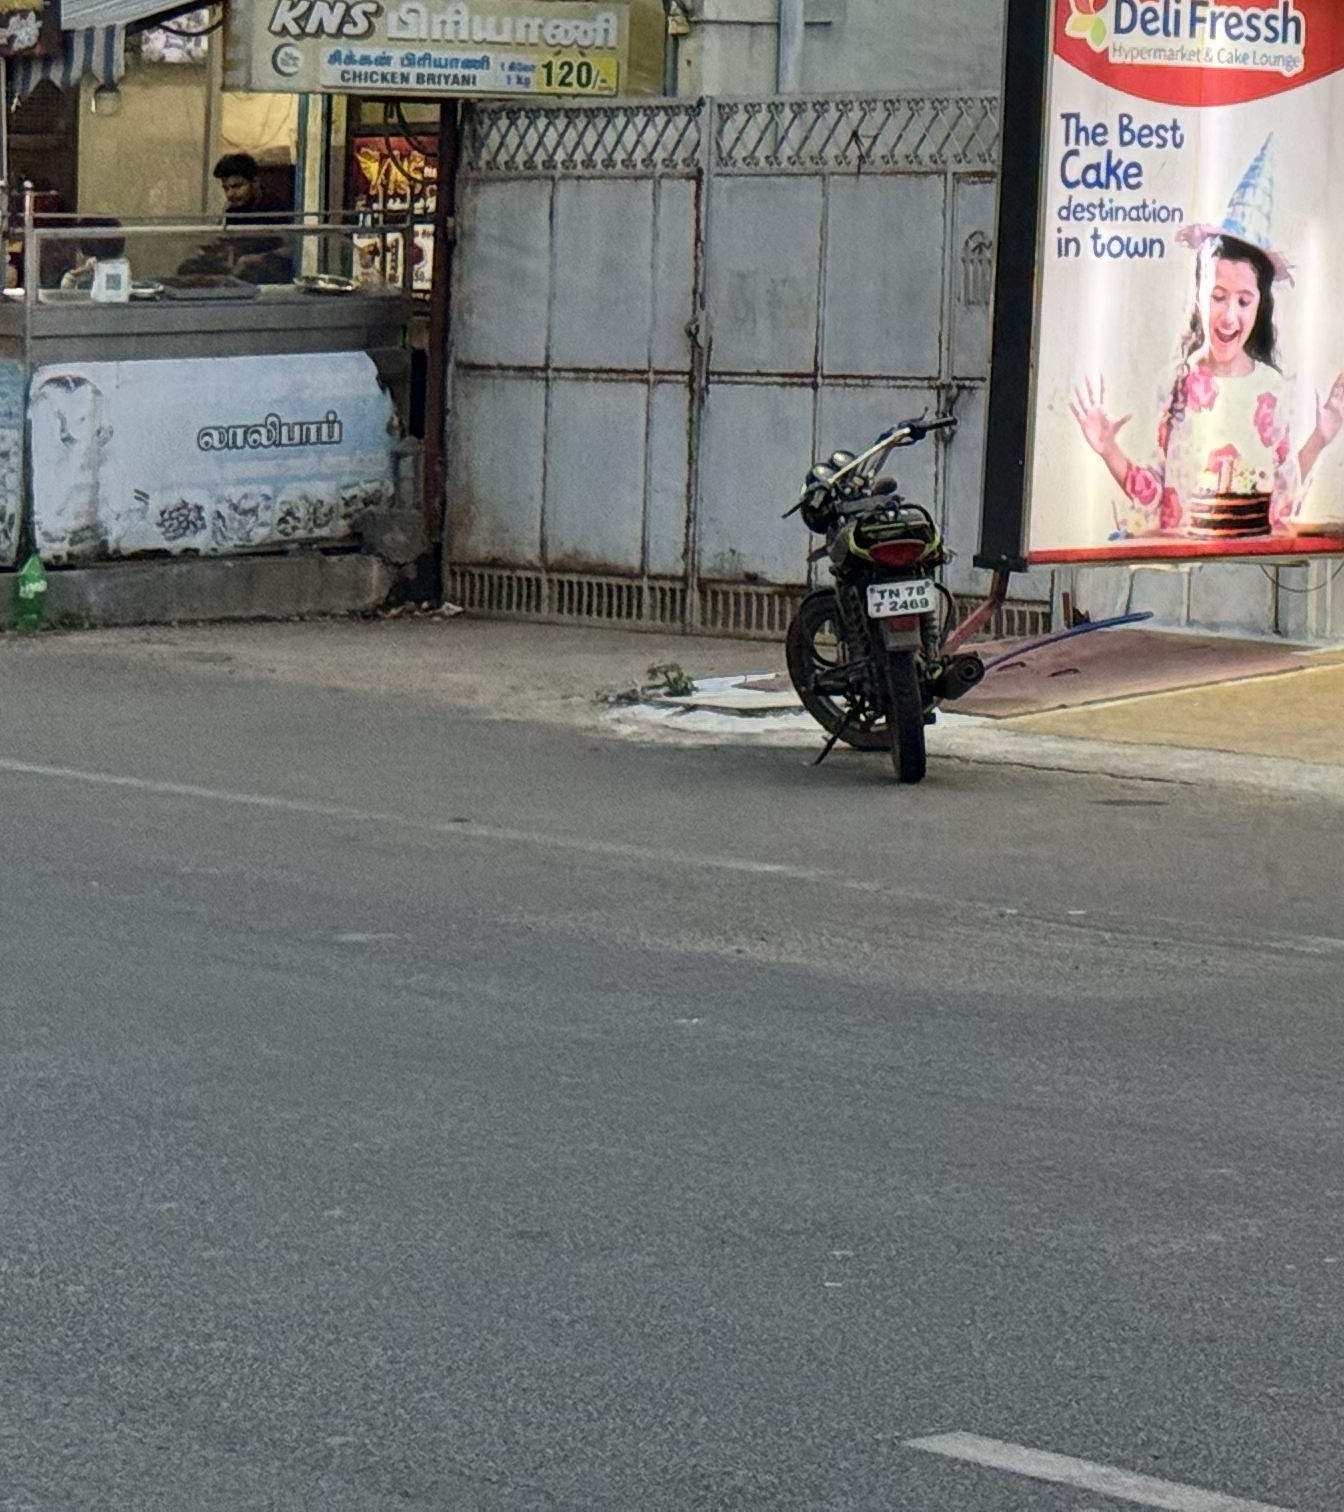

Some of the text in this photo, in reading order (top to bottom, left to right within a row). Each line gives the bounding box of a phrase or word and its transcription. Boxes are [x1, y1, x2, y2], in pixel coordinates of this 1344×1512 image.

[387, 0, 618, 47] பிரியாணி
[1112, 42, 1301, 73] Hypermarket & Cake Lounge
[340, 70, 477, 88] CHICKEN BRIYANI
[1060, 112, 1185, 149] The Best
[1060, 149, 1144, 191] Cake
[1057, 194, 1184, 224] destination
[1057, 228, 1165, 259] in town
[197, 410, 343, 451] லாலிபாப்
[873, 601, 884, 613] T
[876, 588, 901, 600] TN
